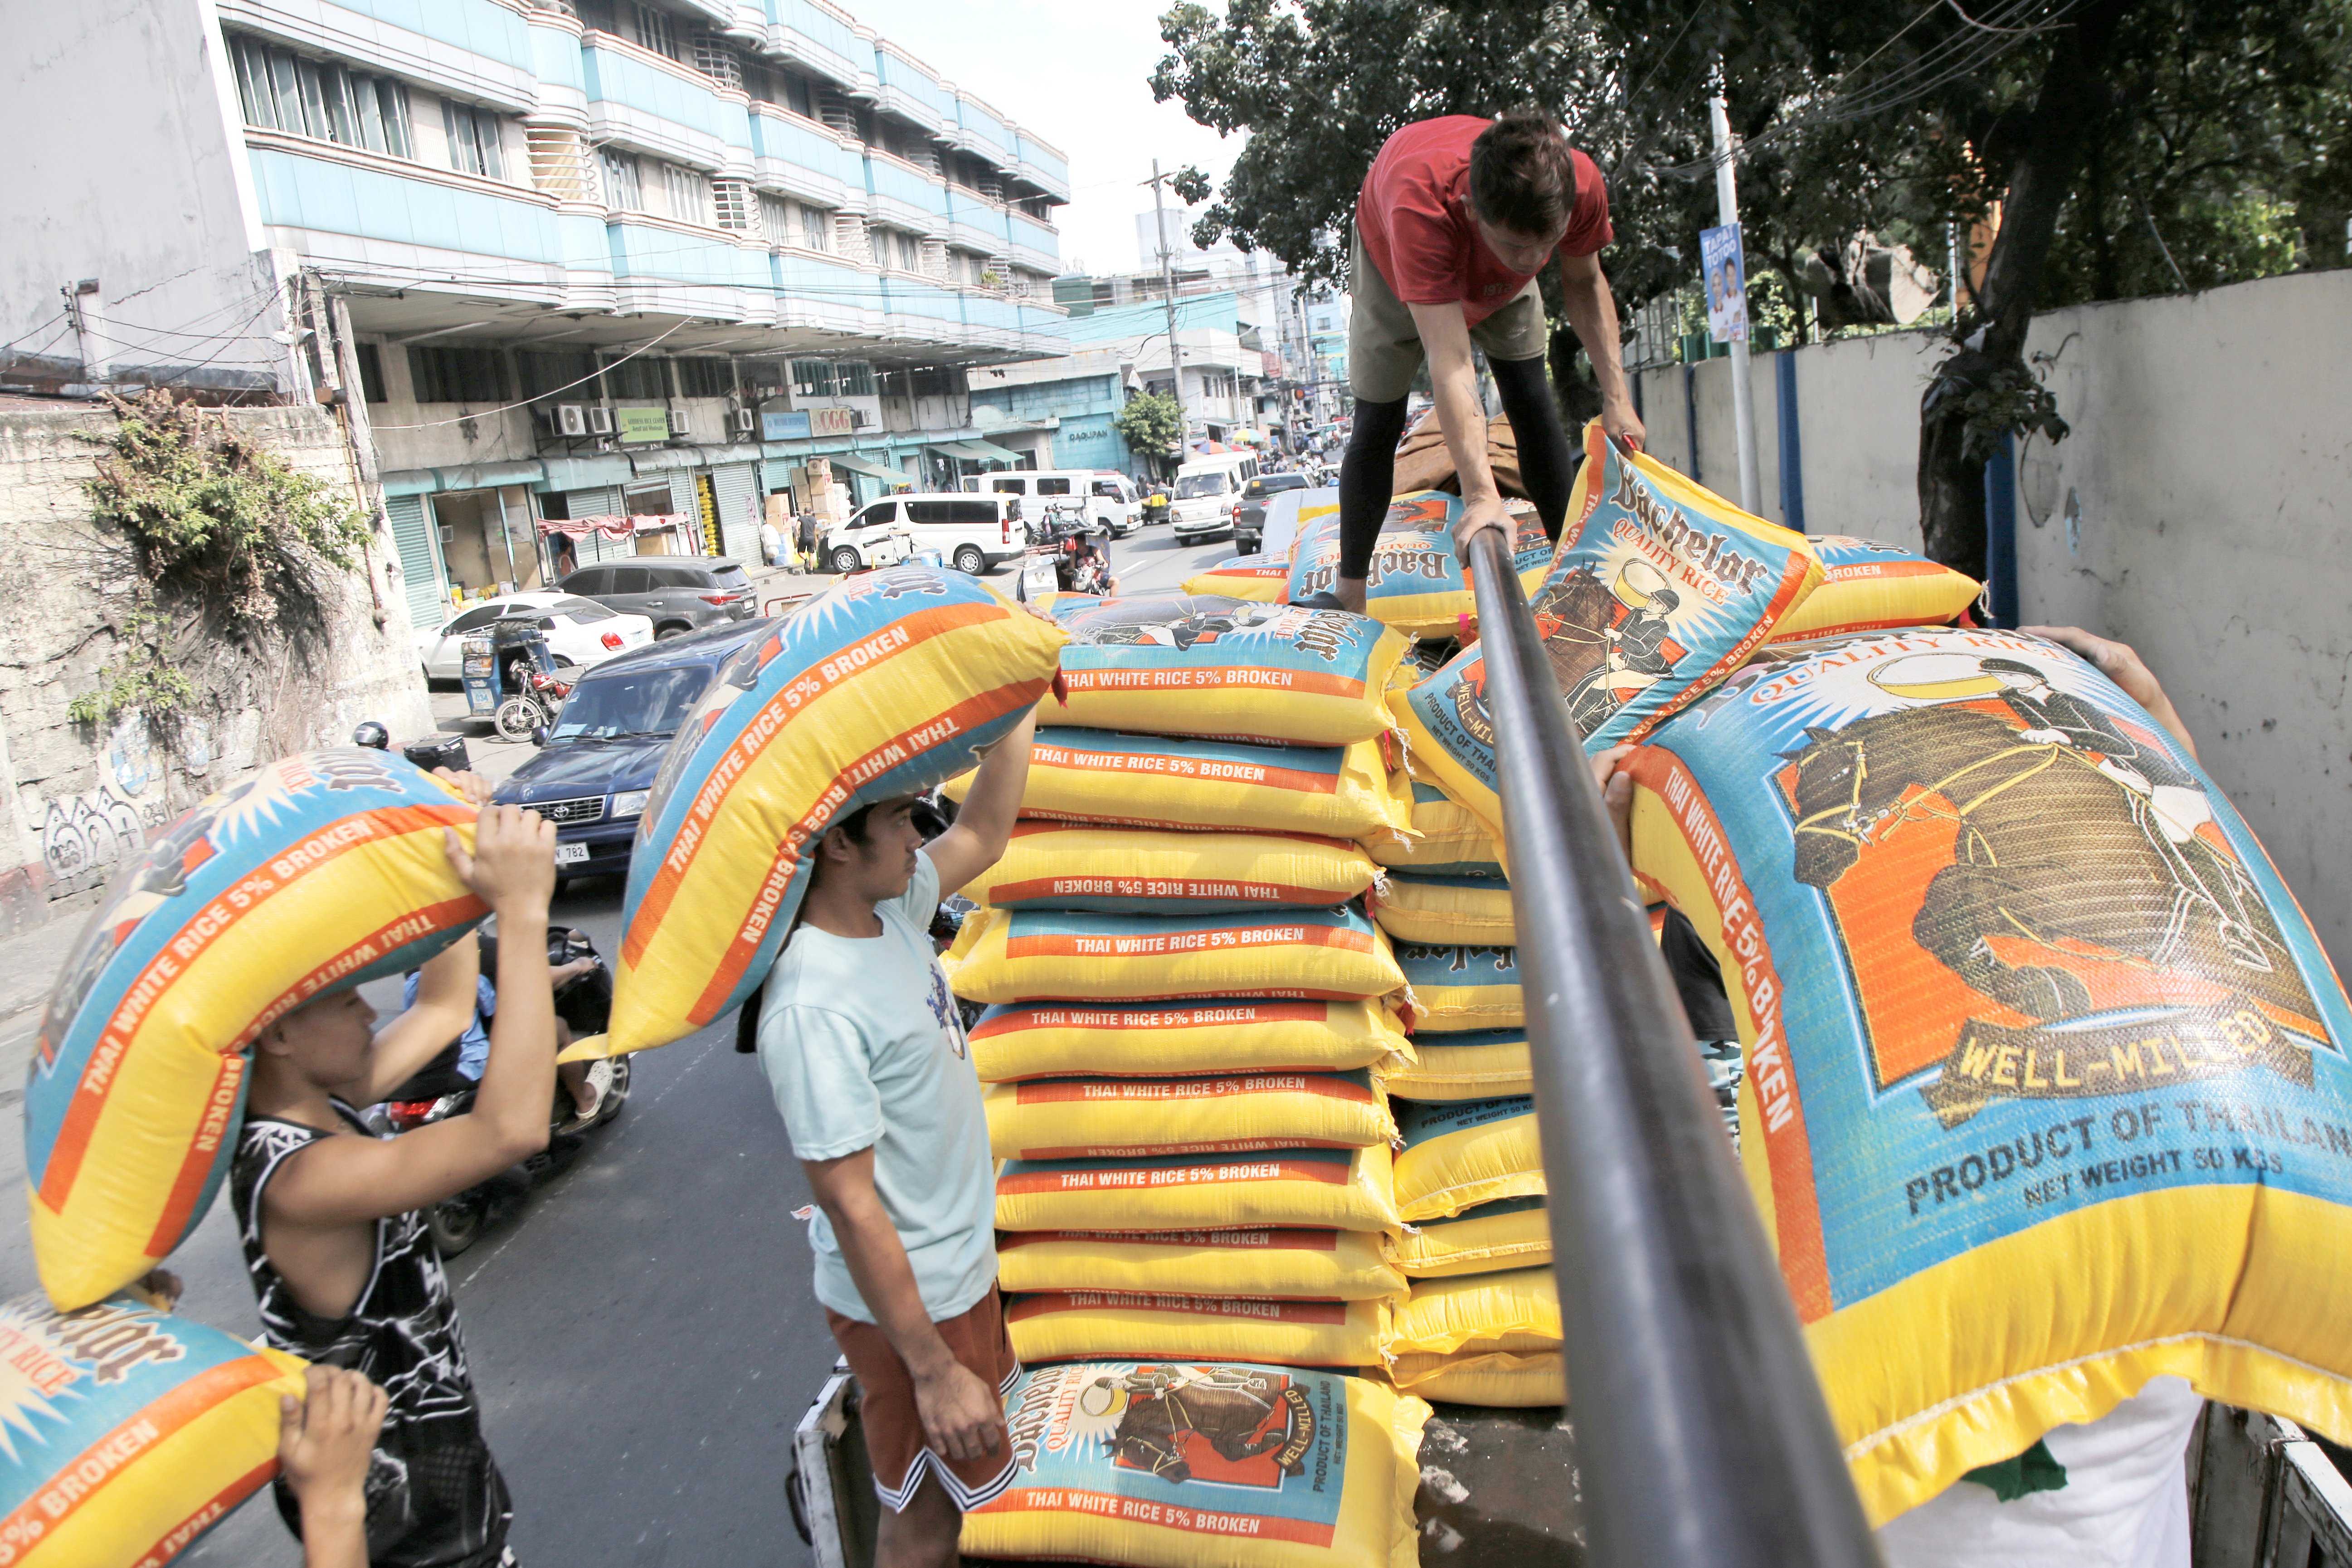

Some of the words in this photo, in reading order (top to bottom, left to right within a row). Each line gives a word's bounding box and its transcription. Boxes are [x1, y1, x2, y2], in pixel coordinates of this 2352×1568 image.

[1704, 225, 1734, 254] TAPAT
[1706, 239, 1737, 268] TOTOO
[820, 410, 850, 430] CGG
[1317, 552, 1341, 566] ICE
[1375, 542, 1431, 551] QUALI
[1613, 518, 1681, 574] QUALITY
[1679, 564, 1730, 606] RICE
[1275, 617, 1299, 639] RICE
[1701, 667, 1725, 686] 5%
[1725, 615, 1774, 666] BROKEN
[1062, 673, 1094, 687] THAI
[1098, 672, 1150, 687] WHITE
[1154, 671, 1190, 686] RICE
[1195, 671, 1222, 685] 5%
[1226, 670, 1293, 686] BROKEN
[1749, 636, 1942, 706] QUALITY
[907, 717, 960, 751] THAI
[1425, 692, 1458, 735] PRODUCT
[1456, 733, 1472, 752] OF
[667, 821, 702, 873] THAI
[696, 756, 746, 819] WHITE
[743, 702, 787, 756] RICE
[786, 674, 821, 708] 5%
[821, 625, 910, 684] BROKEN
[1033, 748, 1068, 764] THAI
[1073, 753, 1123, 768] WHITE
[1127, 756, 1165, 771] RICE
[1169, 760, 1194, 774] 5%
[1200, 762, 1265, 781] BROKEN
[1431, 725, 1444, 740] NET
[1442, 735, 1466, 762] WEIGHT
[1465, 758, 1475, 770] 50
[1474, 766, 1491, 783] KGS
[803, 784, 848, 832] RICE
[1029, 811, 1089, 822] BROKEN
[566, 847, 584, 858] 782
[1053, 880, 1113, 894] BROKEN
[1117, 881, 1143, 895] 5%
[1147, 881, 1183, 895] RICE
[1188, 882, 1239, 897] WHITE
[1244, 883, 1280, 899] THAI
[1664, 765, 1691, 815] THAI
[1685, 797, 1726, 879] WHITE
[1713, 864, 1748, 935] RICE
[1736, 925, 1763, 987] 5%
[741, 858, 794, 944] BROKEN
[382, 914, 436, 949] THAI
[1075, 939, 1111, 953] THAI
[1115, 936, 1166, 953] WHITE
[1169, 934, 1208, 950] RICE
[1211, 932, 1237, 946] 5%
[1241, 927, 1304, 945] BROKEN
[83, 1045, 122, 1097] THAI
[115, 959, 179, 1036] WHITE
[173, 903, 233, 960] RICE
[228, 875, 273, 909] 5%
[276, 818, 375, 880] BROKEN
[302, 943, 379, 994] WHITE
[1031, 1012, 1066, 1024] THAI
[1070, 1012, 1119, 1025] WHITE
[1124, 1013, 1159, 1026] RICE
[1164, 1012, 1189, 1025] 5%
[1193, 1008, 1256, 1023] BROKEN
[1959, 1008, 2273, 1091] WELL-MILLED
[1083, 1084, 1118, 1098] THAI
[1123, 1083, 1172, 1099] WHITE
[1174, 1082, 1213, 1097] RICE
[1217, 1080, 1241, 1094] 5%
[1245, 1076, 1305, 1091] BROKEN
[197, 1058, 241, 1152] BROKEN
[1456, 1117, 1473, 1127] NET
[1475, 1109, 1508, 1122] WEIGHT
[1088, 1148, 1146, 1156] BROKEN
[1181, 1144, 1215, 1153] RICE
[1221, 1142, 1267, 1150] WHITE
[1905, 1114, 2096, 1215] PRODUCT
[2111, 1100, 2164, 1142] OF
[2175, 1099, 2352, 1159] THAILAN
[1061, 1174, 1094, 1188] THAI
[1099, 1171, 1146, 1186] WHITE
[1150, 1169, 1185, 1184] RICE
[1190, 1168, 1214, 1181] 5%
[1218, 1164, 1280, 1179] BROKEN
[2023, 1172, 2072, 1210] NET
[2079, 1149, 2182, 1189] WEIGHT
[2193, 1146, 2225, 1170] 50
[1183, 1232, 1205, 1243] 5%
[1211, 1232, 1269, 1244] BROKEN
[1069, 1293, 1101, 1306] THAI
[1106, 1294, 1152, 1306] WHITE
[1157, 1296, 1190, 1309] RICE
[1195, 1298, 1217, 1311] 5%
[1222, 1300, 1280, 1317] BROKEN
[8, 1344, 78, 1397] RICE
[1047, 1387, 1078, 1450] QUALITY
[1066, 1365, 1087, 1385] RICE
[1320, 1380, 1332, 1422] THAILAND
[1278, 1390, 1311, 1466] WELL-MILLED
[1320, 1423, 1332, 1437] OF
[39, 1417, 160, 1519] BROKEN
[1313, 1439, 1330, 1492] PRODUCT
[162, 1502, 227, 1553] THAI
[1027, 1492, 1062, 1507] THAI
[1068, 1493, 1118, 1514] WHITE
[1123, 1500, 1161, 1521] RICE
[1165, 1509, 1190, 1527] 5%
[1196, 1514, 1260, 1534] BROKEN
